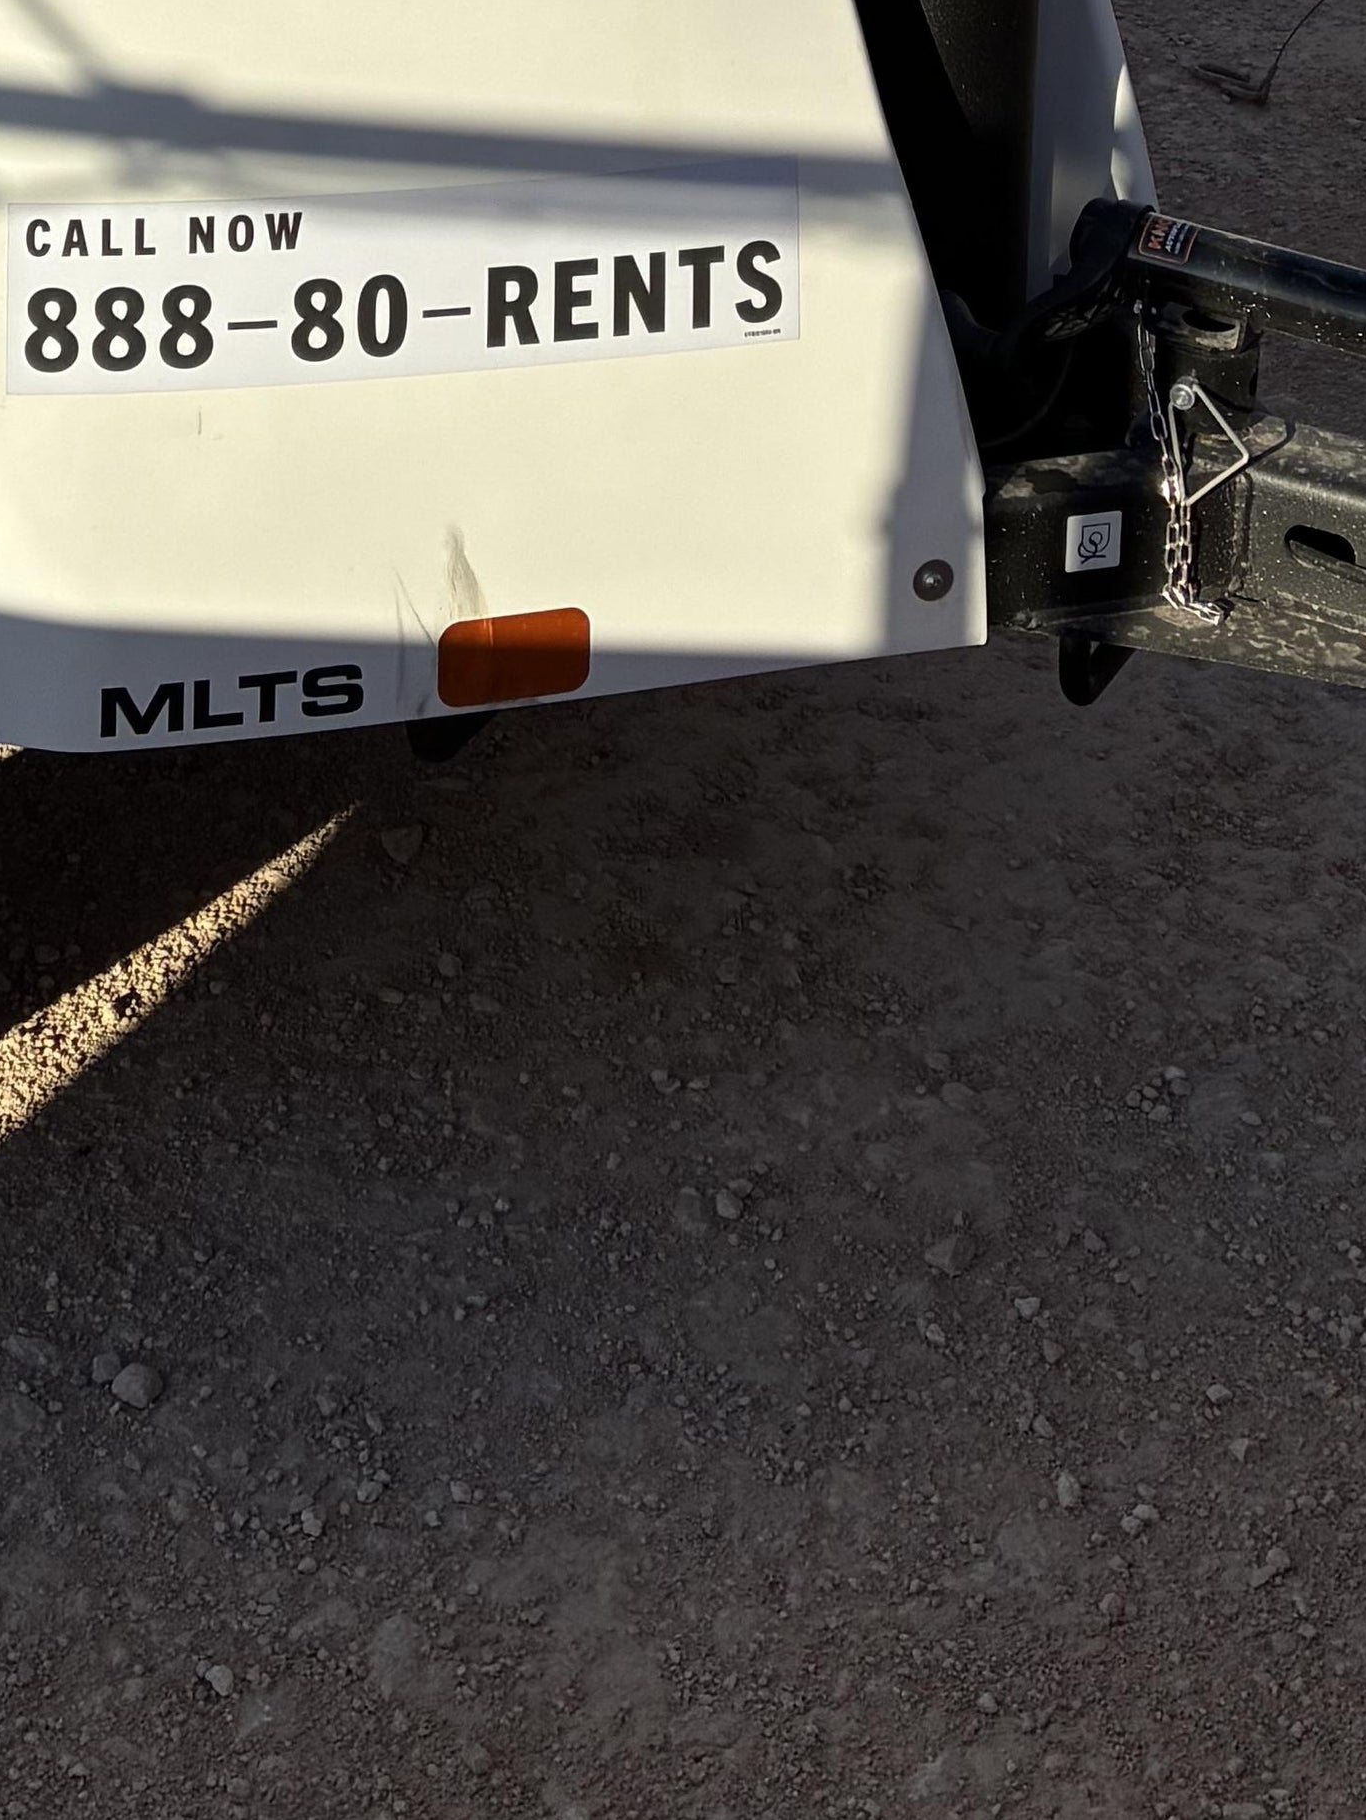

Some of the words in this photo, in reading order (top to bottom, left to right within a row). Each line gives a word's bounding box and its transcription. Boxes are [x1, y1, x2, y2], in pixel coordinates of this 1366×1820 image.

[26, 217, 157, 258] CALL
[188, 211, 304, 255] NOW
[25, 239, 784, 374] 888-80-RENTS
[99, 663, 364, 738] MLTS
